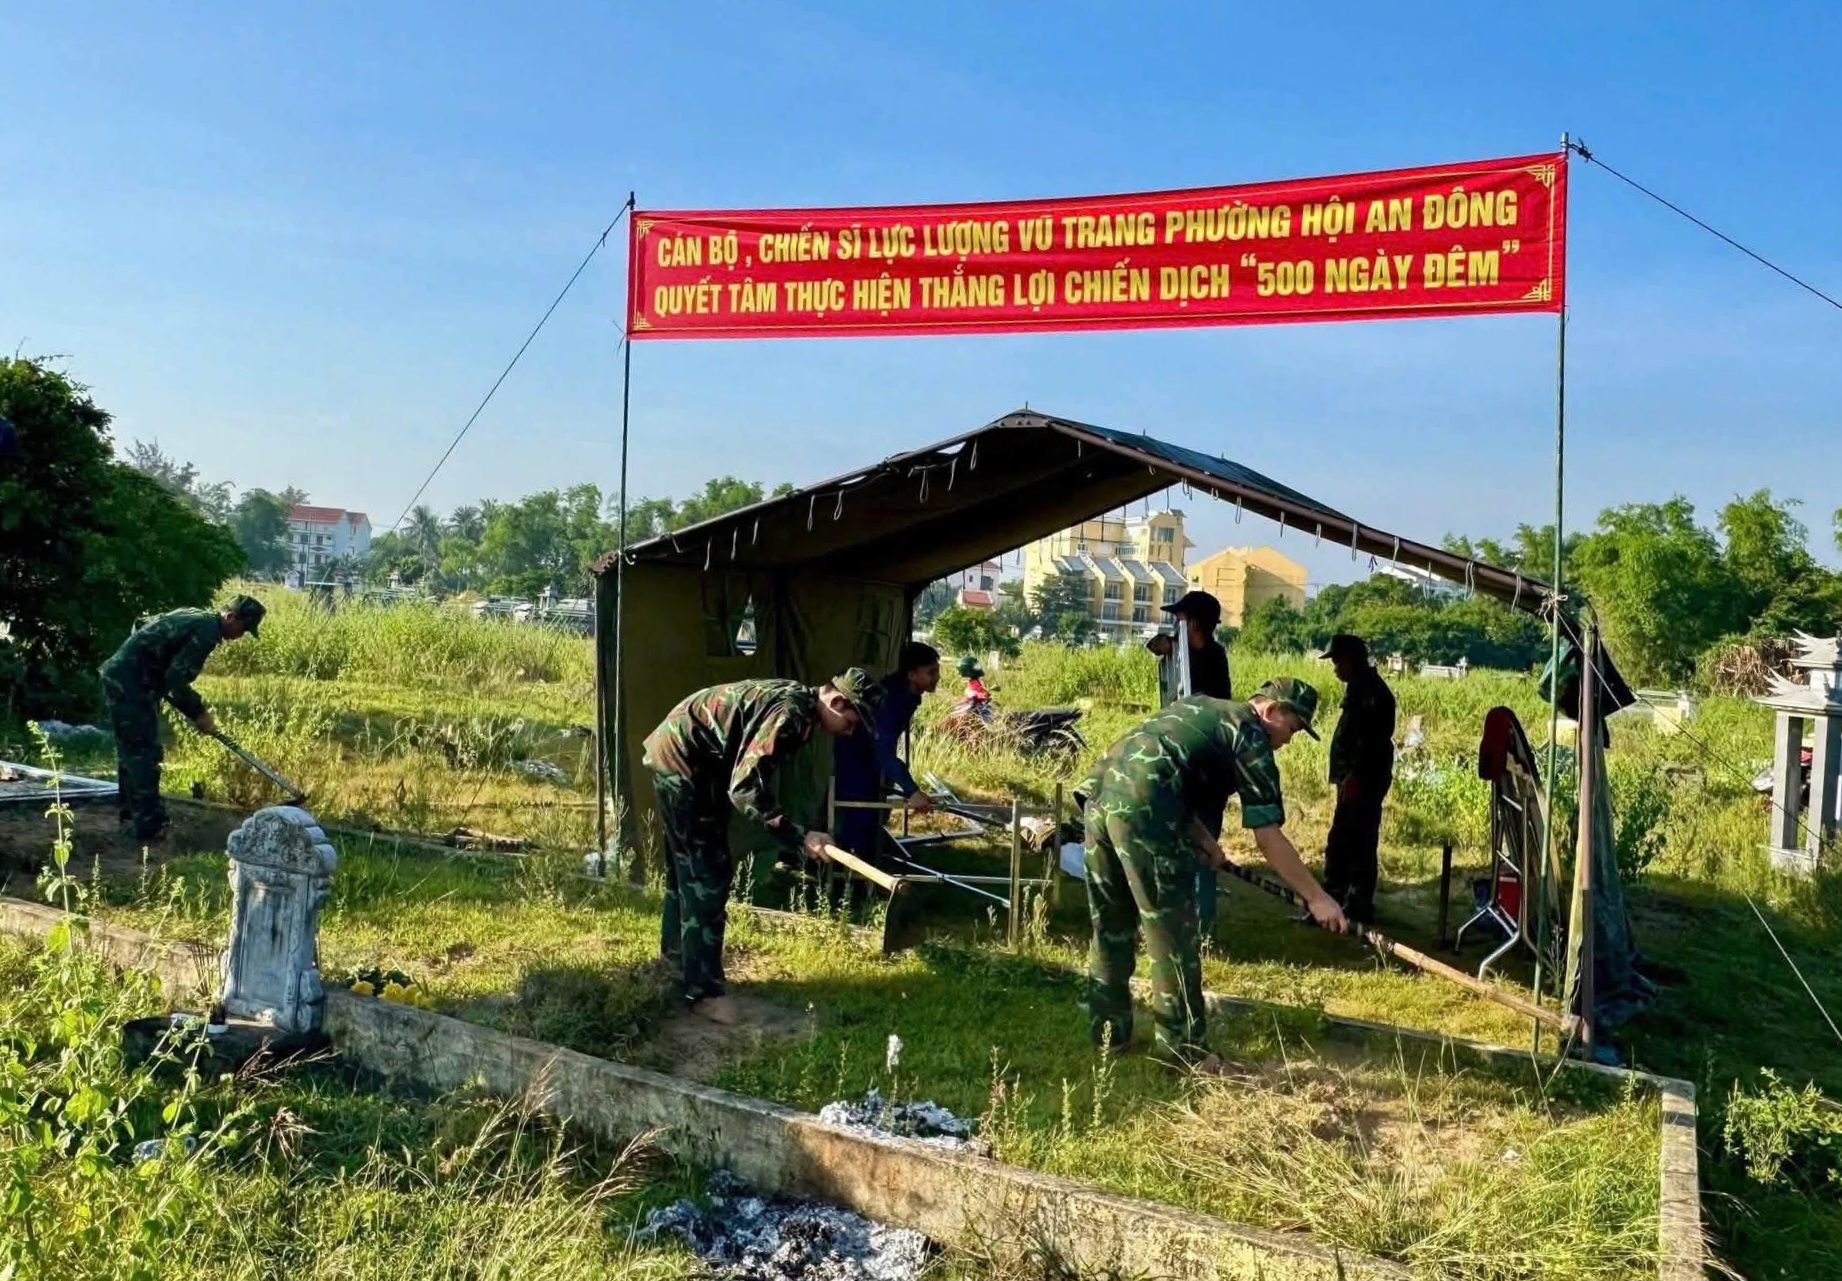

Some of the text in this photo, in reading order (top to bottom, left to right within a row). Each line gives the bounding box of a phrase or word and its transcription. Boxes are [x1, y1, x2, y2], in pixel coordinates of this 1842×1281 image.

[758, 222, 830, 263] CHIẾN
[837, 223, 862, 260] SĨ
[868, 224, 915, 264] LỰC
[923, 219, 1010, 261] LƯỢNG
[1018, 214, 1054, 252] VŨ
[1062, 213, 1156, 249] TRANG
[1164, 201, 1291, 243] PHƯỜNG
[1301, 195, 1355, 243] HỘI
[1365, 198, 1413, 232] AN
[1422, 186, 1518, 230] ĐÔNG
[654, 239, 1521, 317] QUYẾT TÂM THỰC HIỆN THẮNG LỢI CHIẾN DỊCH “500 NGÀY ĐÊM”
